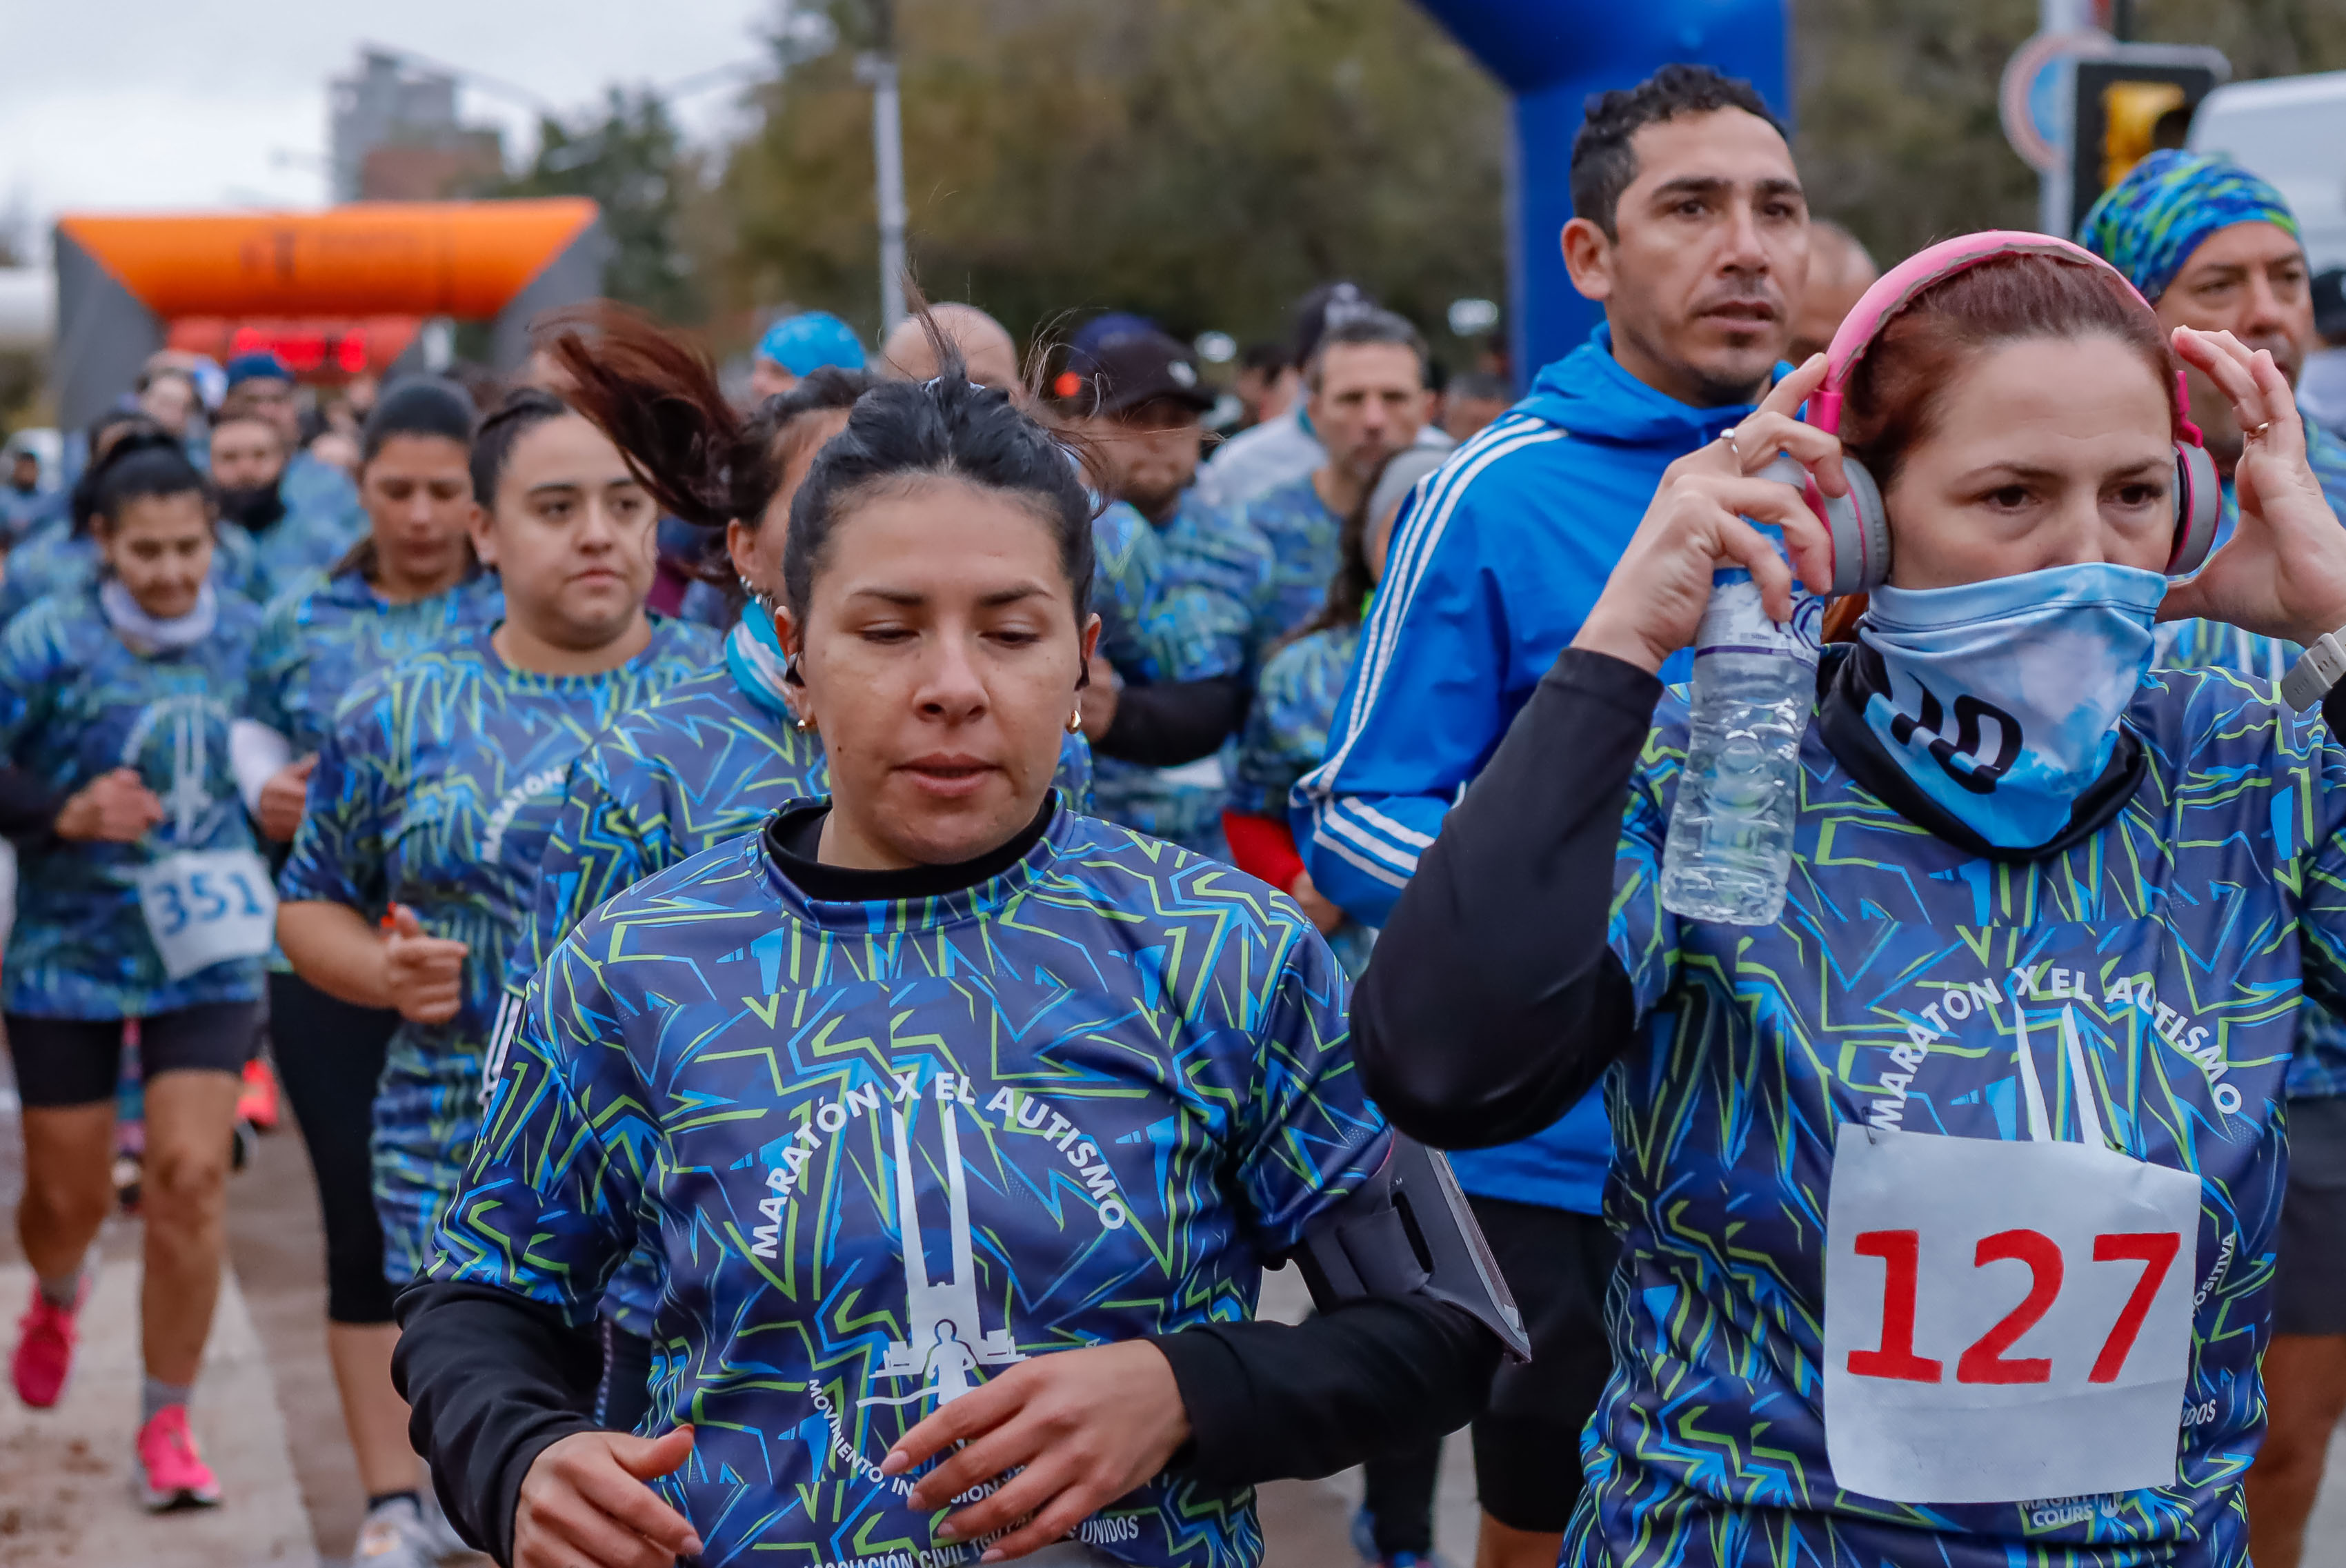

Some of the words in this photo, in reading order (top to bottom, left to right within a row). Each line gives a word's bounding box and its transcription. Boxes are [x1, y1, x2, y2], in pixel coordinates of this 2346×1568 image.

[155, 871, 264, 937] 351
[1869, 978, 2002, 1132] MARATÓN
[2012, 966, 2040, 997] X
[2051, 969, 2094, 1002] EL
[2106, 976, 2242, 1115] AUTISMO
[750, 1082, 881, 1260] MARATÓN
[893, 1072, 922, 1103] X
[935, 1072, 977, 1105] EL
[985, 1086, 1127, 1231] AUTISMO
[1847, 1228, 2181, 1385] 127
[2192, 1231, 2236, 1318] OSITIVA
[919, 1544, 969, 1568] CIVIL
[1080, 1514, 1139, 1544] UNIDOS
[2032, 1503, 2094, 1527] COURS
